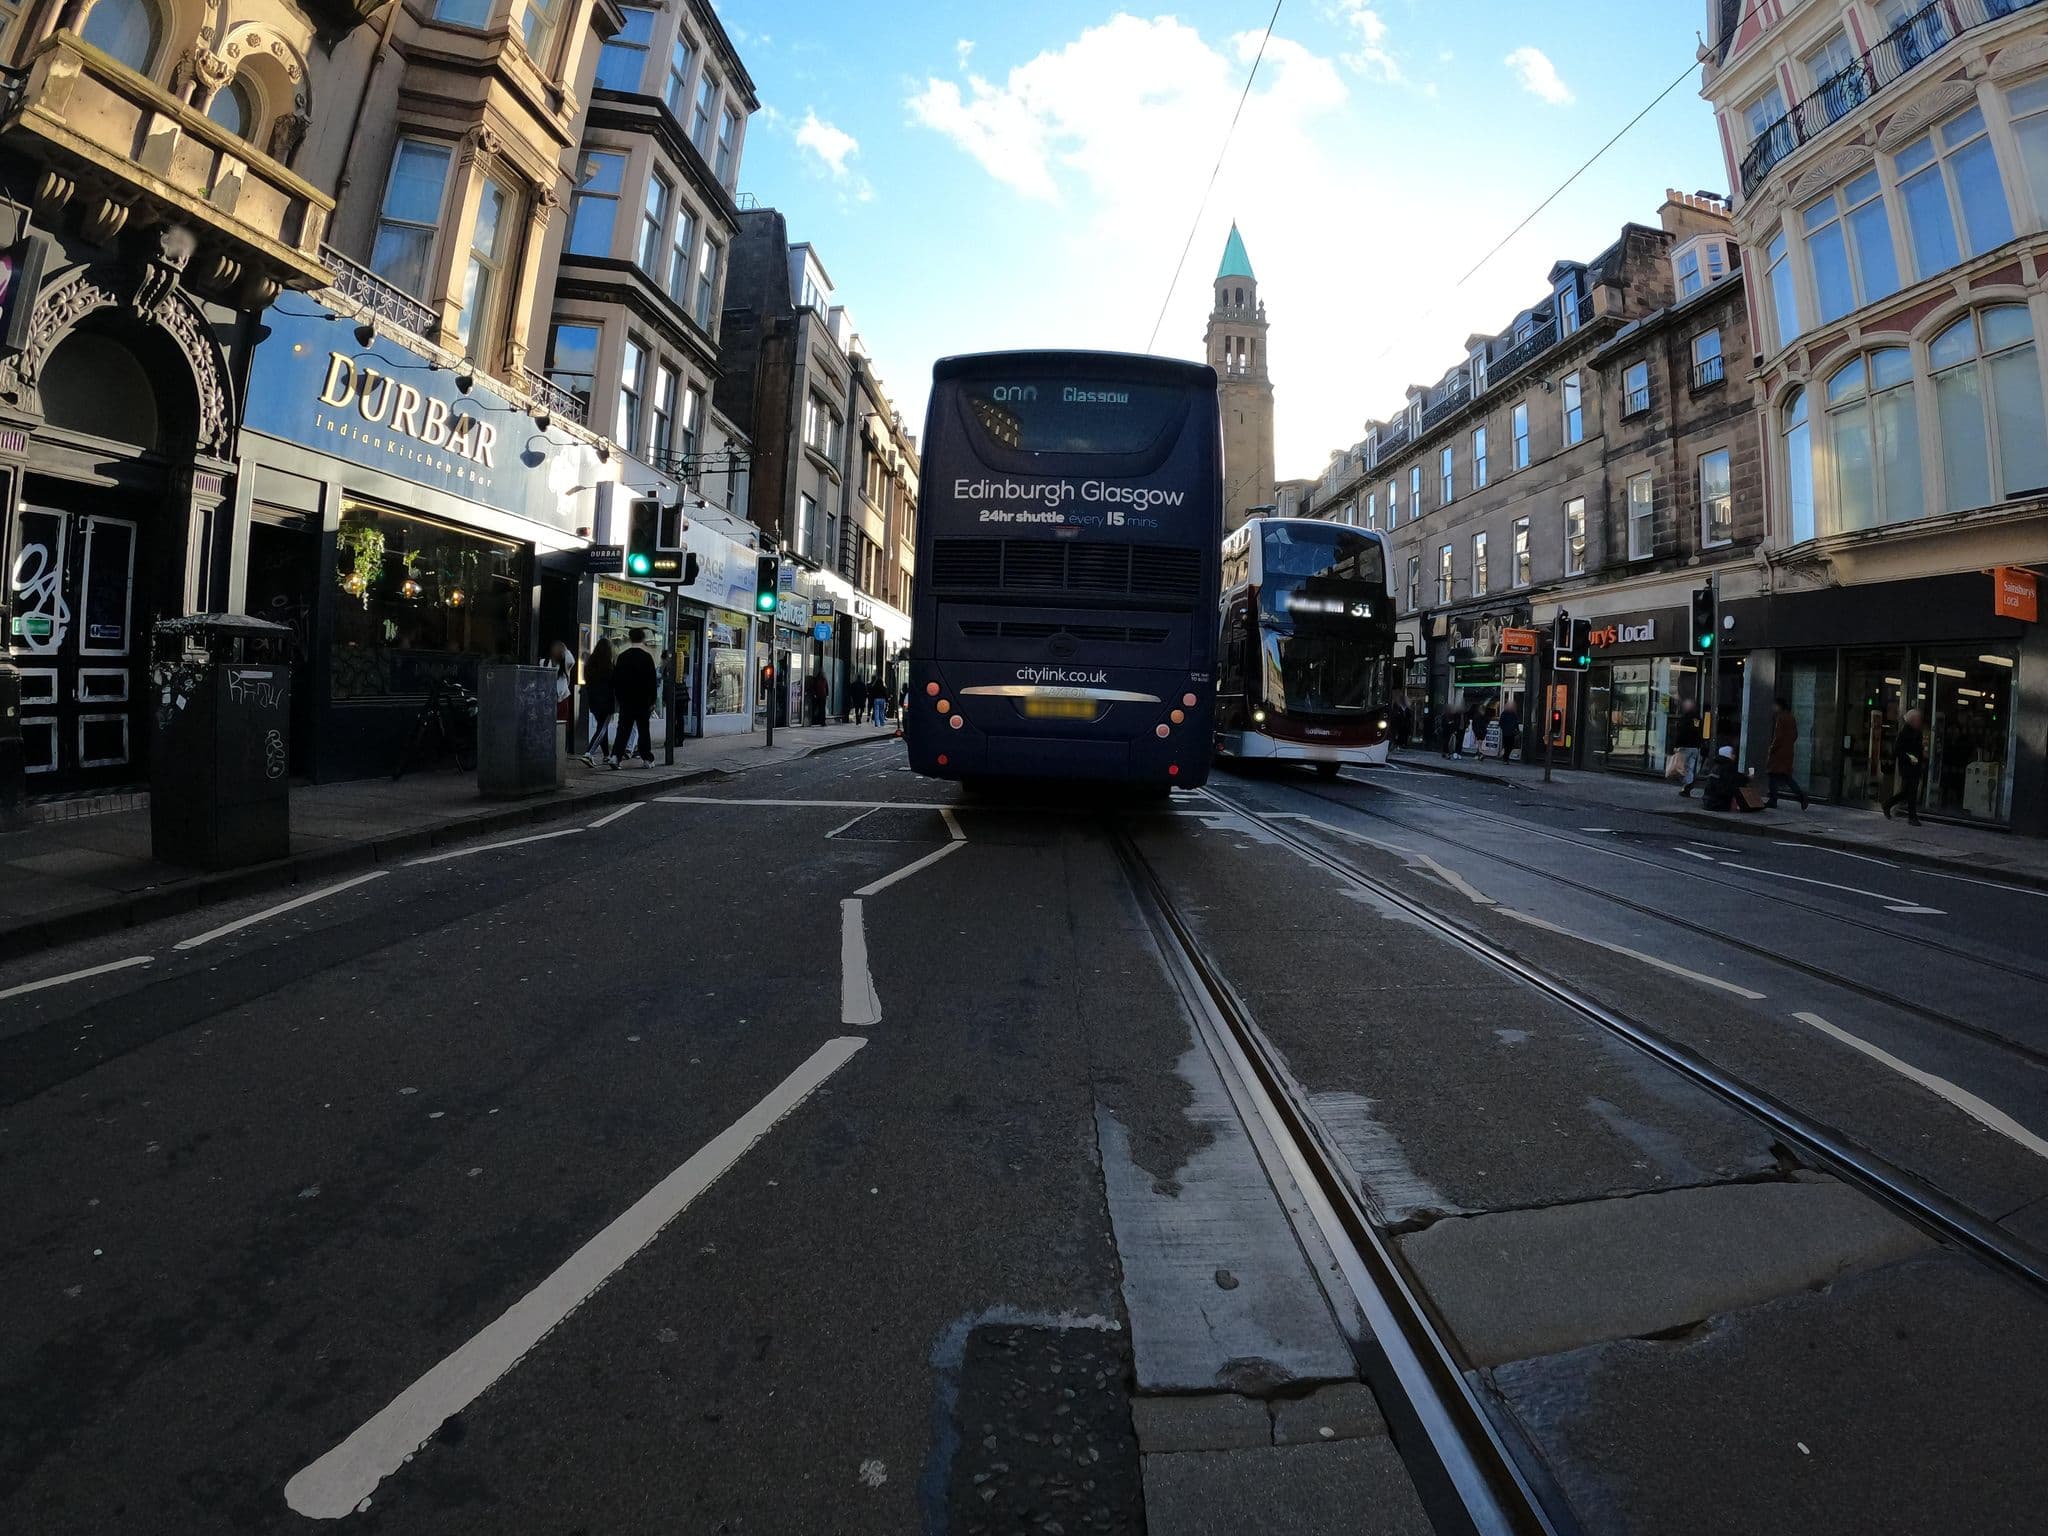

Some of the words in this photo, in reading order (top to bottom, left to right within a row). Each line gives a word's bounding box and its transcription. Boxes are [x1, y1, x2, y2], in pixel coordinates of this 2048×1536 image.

[1063, 386, 1129, 403] Glasgow
[319, 351, 497, 470] DURBAR
[315, 414, 381, 449] Indian
[387, 440, 452, 475] Kitchen
[456, 466, 465, 478] &
[469, 470, 493, 488] Bar
[953, 479, 1075, 507] Edinburgh
[1080, 480, 1185, 511] Glasgow
[979, 509, 1014, 523] 24hr
[1015, 510, 1065, 524] shuttle
[1068, 512, 1105, 527] every
[1106, 511, 1125, 526] 15
[1127, 515, 1158, 528] mins
[590, 550, 621, 558] DURBAR
[2003, 580, 2037, 599] Sainsbury's
[2003, 593, 2020, 608] Local
[1618, 618, 1655, 643] Local
[1016, 666, 1108, 684] citylink.co.uk
